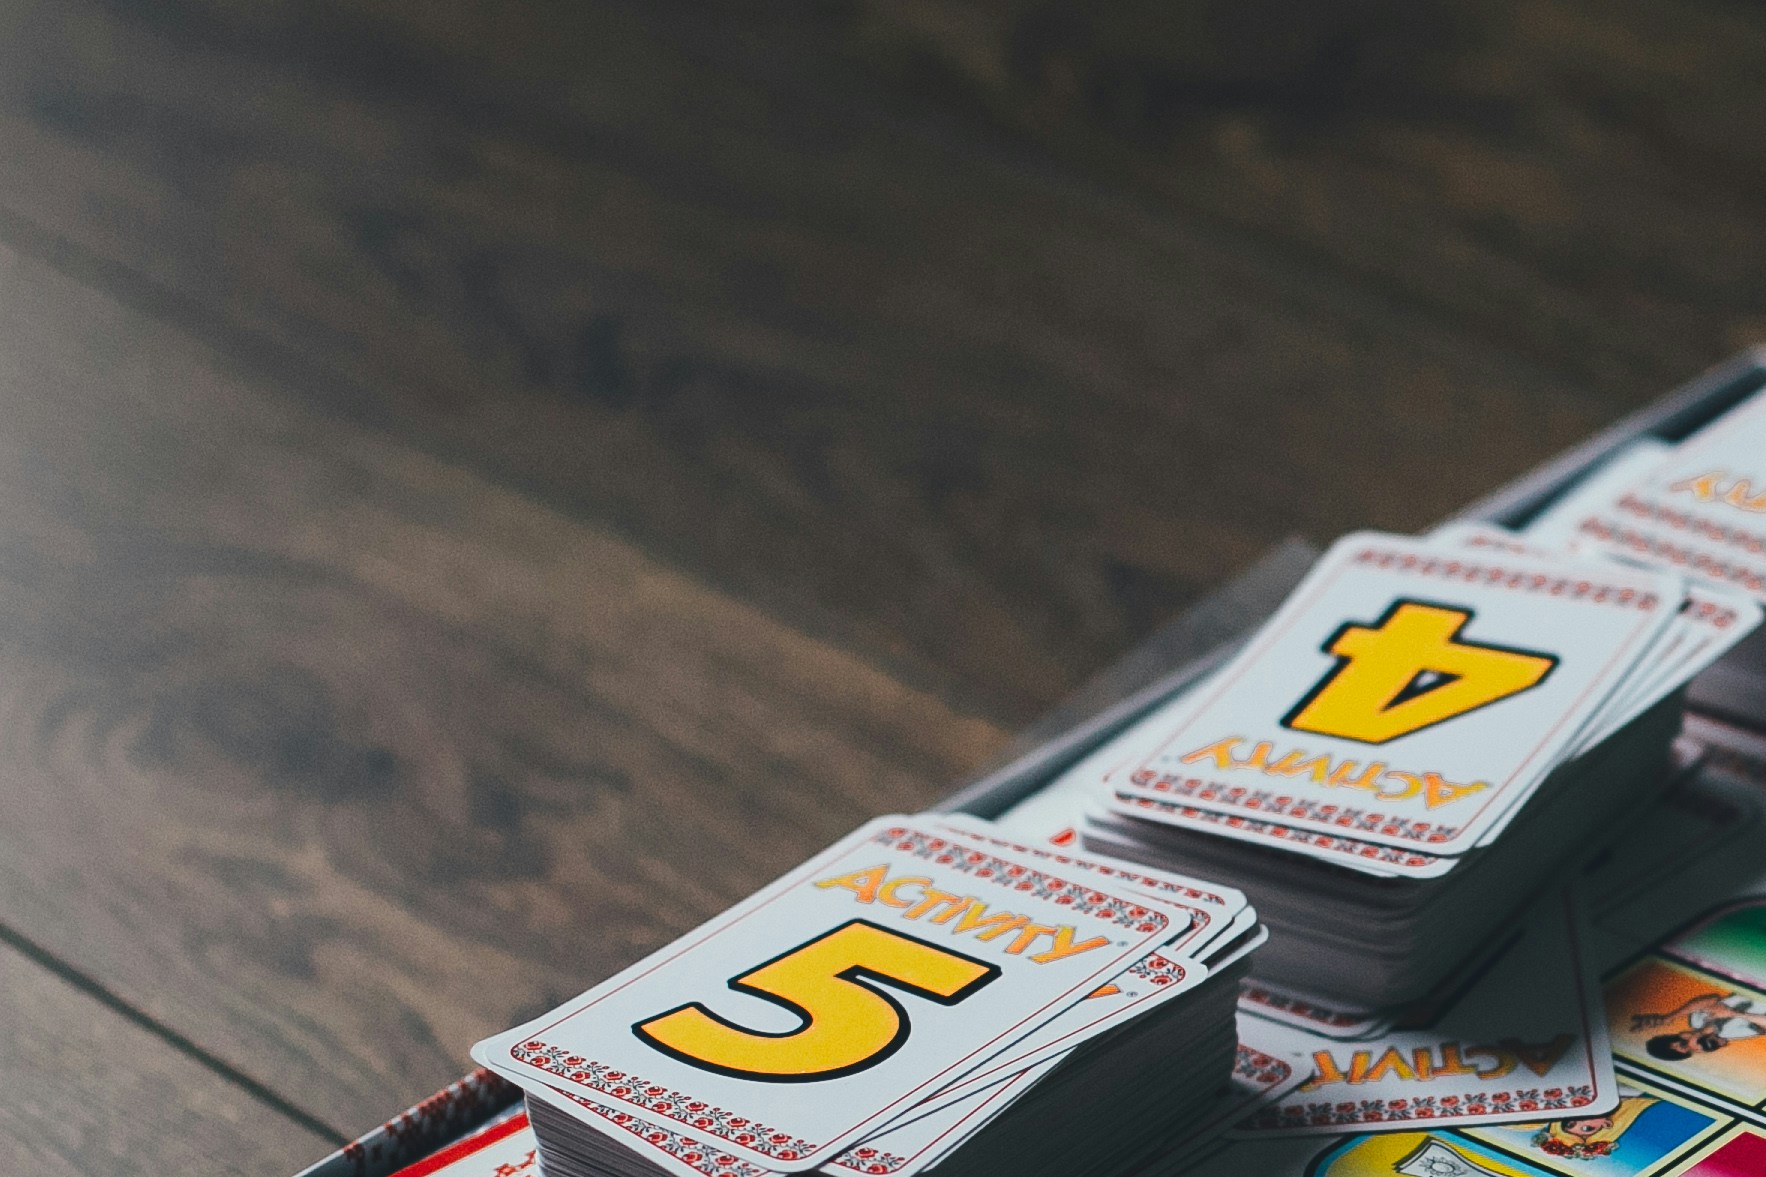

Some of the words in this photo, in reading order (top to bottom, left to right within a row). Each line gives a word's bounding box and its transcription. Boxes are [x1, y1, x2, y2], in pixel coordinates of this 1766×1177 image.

[1280, 597, 1561, 744] 4
[1178, 735, 1491, 810] ACTIVITY
[813, 863, 1111, 964] ACTIVITY
[631, 918, 1002, 1084] 5
[1299, 1033, 1578, 1092] ACTIVIT
